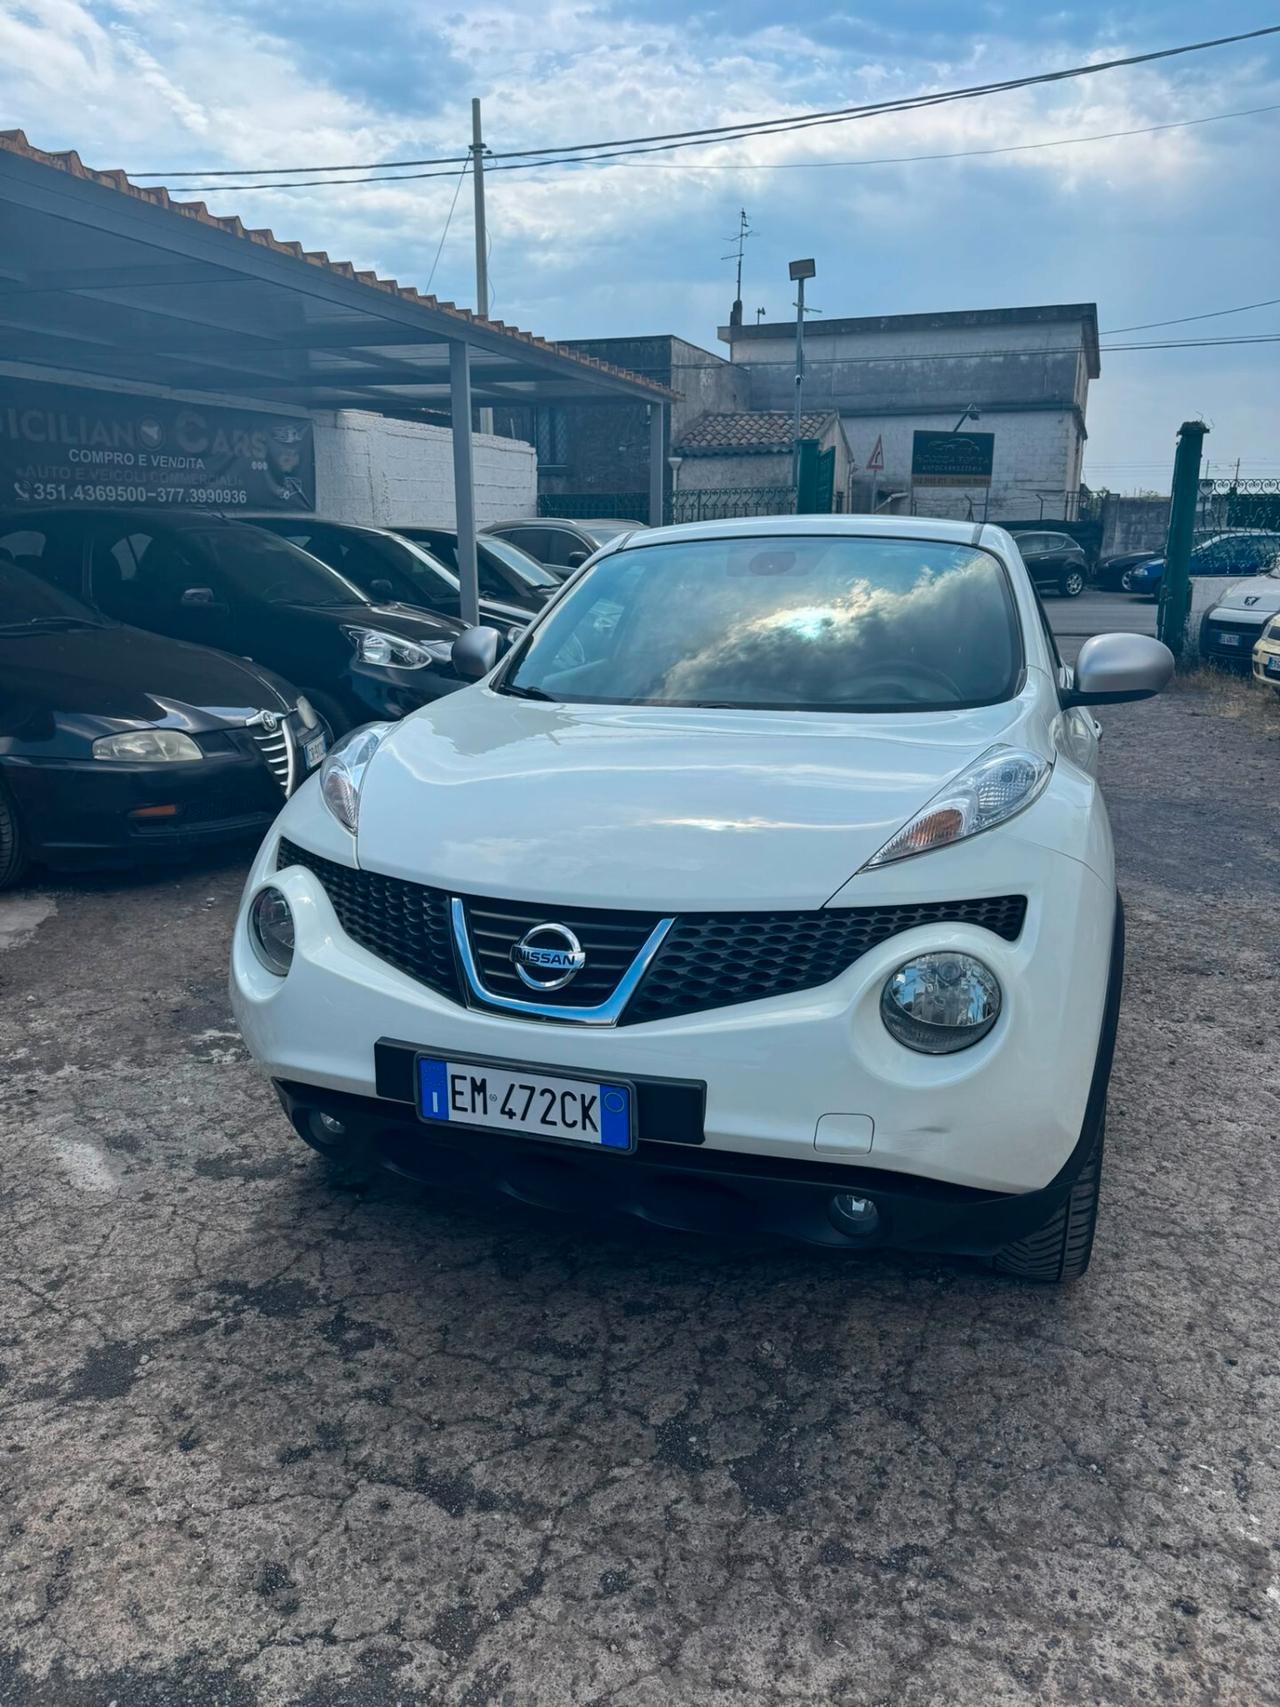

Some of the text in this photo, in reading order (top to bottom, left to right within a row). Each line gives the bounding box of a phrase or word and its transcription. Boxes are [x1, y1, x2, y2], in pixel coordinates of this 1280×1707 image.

[68, 448, 206, 471] COMPRO E VENDITA
[75, 467, 85, 480] E
[89, 468, 146, 483] VEICOLI
[515, 949, 576, 966] NISSAN
[450, 1074, 489, 1116] EM
[500, 1083, 599, 1133] 472CK
